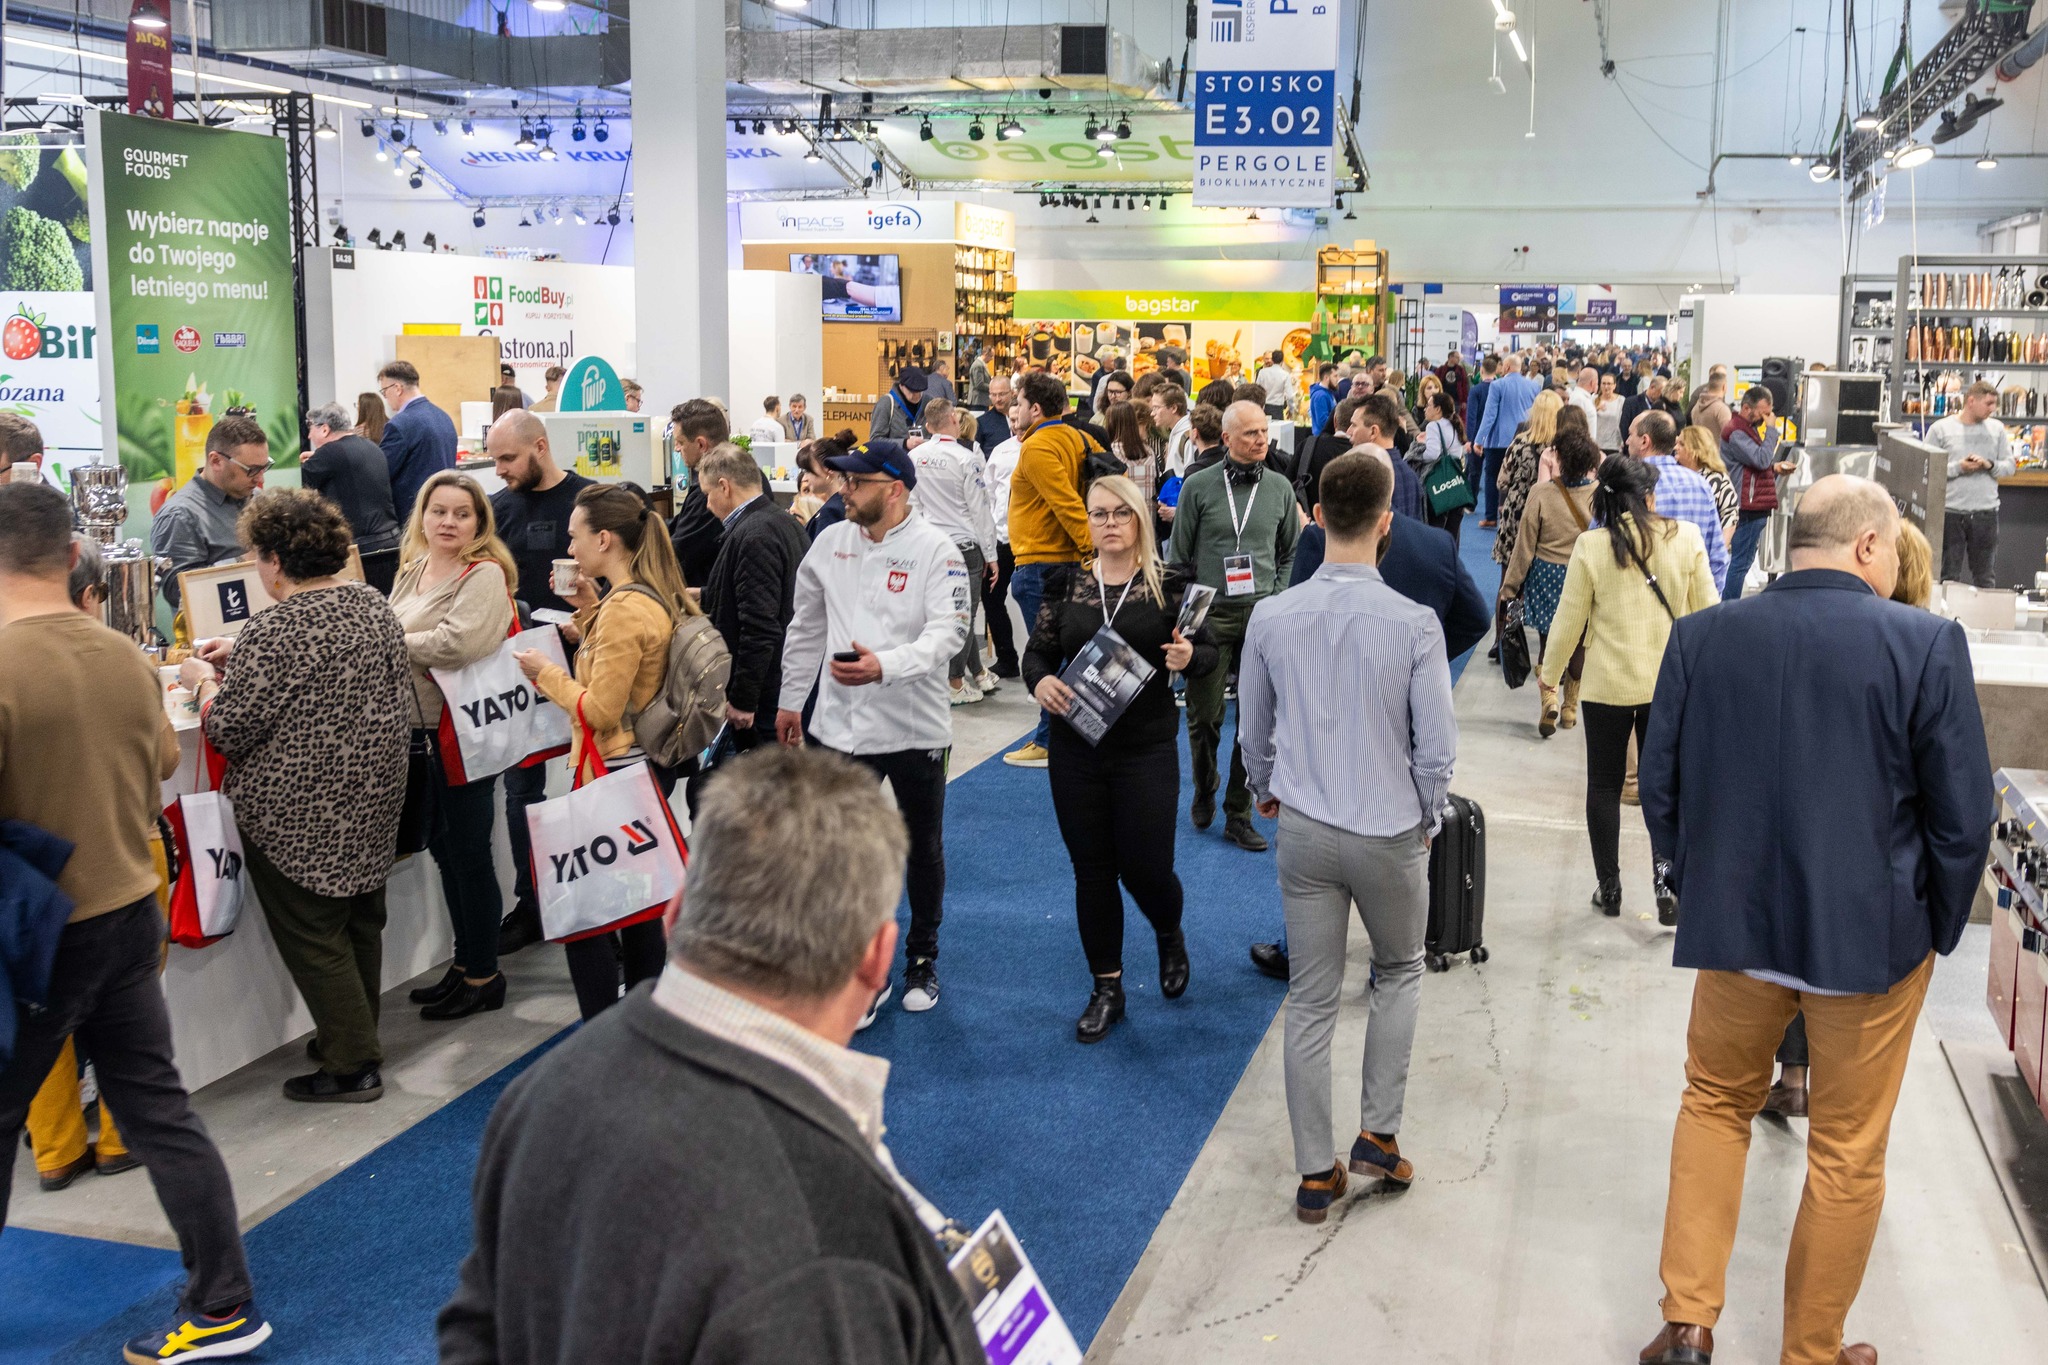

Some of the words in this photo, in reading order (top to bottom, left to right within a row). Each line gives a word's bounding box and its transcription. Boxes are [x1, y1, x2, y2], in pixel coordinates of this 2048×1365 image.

[1205, 75, 1323, 93] STOISKO
[1206, 103, 1321, 135] E3.02
[123, 147, 189, 168] GOURMET
[467, 151, 559, 162] HENR
[1200, 155, 1326, 172] PERGOLE
[125, 162, 171, 180] FOODS
[1199, 177, 1325, 187] BIOKLIMATYCZNE
[126, 209, 204, 239] Wybierz
[208, 218, 269, 246] napoje
[868, 209, 911, 230] igefa
[129, 242, 155, 265] do
[158, 244, 236, 275] Twojego
[131, 274, 208, 305] letniego
[213, 280, 268, 300] menu!
[509, 285, 574, 309] FoodBuy.pl
[525, 312, 540, 320] KUPUJ
[1125, 295, 1200, 316] bagstar
[460, 684, 529, 728] YATO
